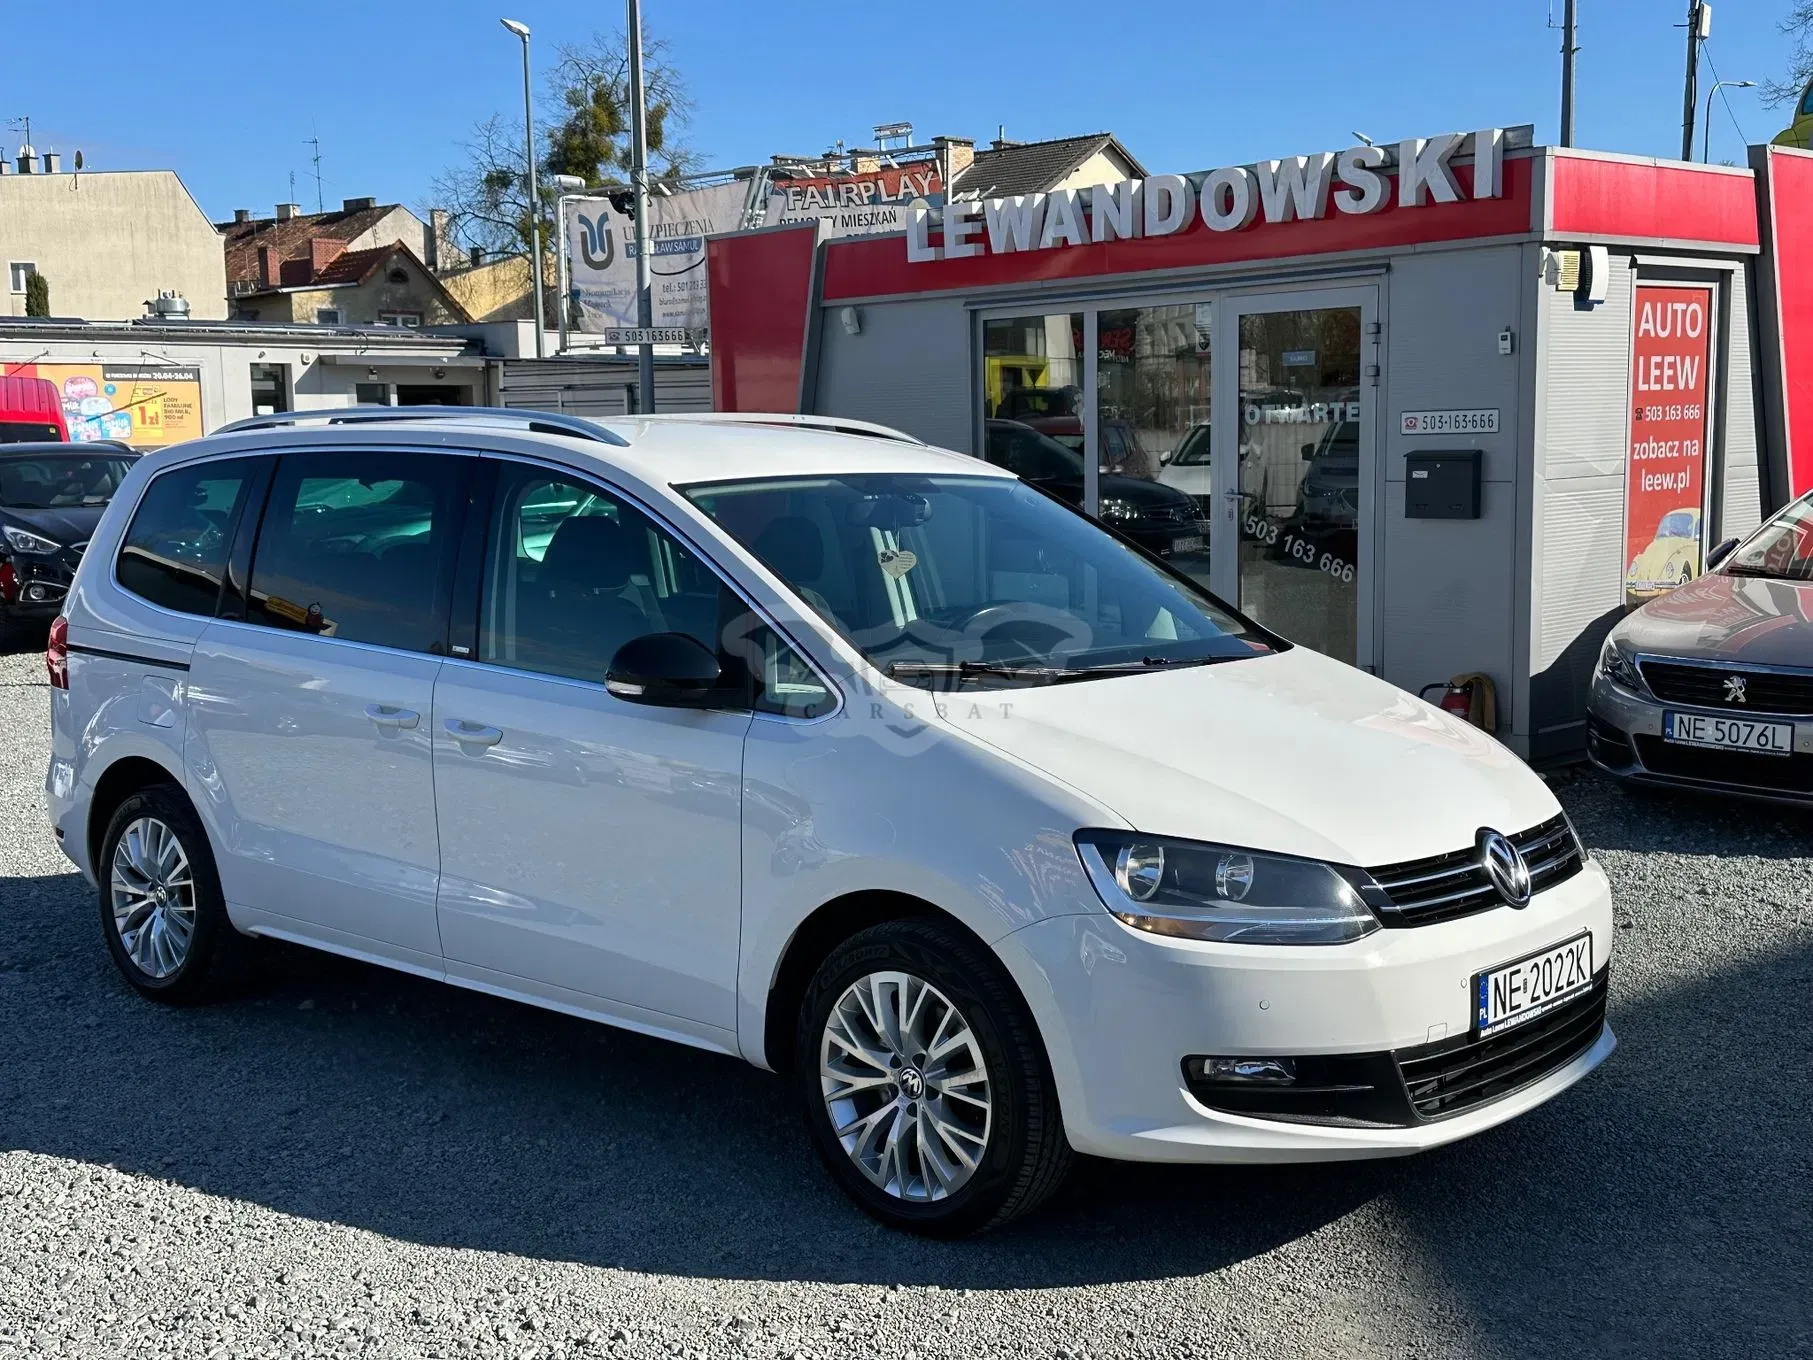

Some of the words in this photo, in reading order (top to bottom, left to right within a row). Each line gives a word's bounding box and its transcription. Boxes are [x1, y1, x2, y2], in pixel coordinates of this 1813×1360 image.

[785, 170, 934, 211] FAIRPLAY
[906, 127, 1504, 263] LEWANDOWSKI
[623, 218, 715, 241] UZPIECZENIA
[841, 206, 898, 228] MIESZKAŃ
[1638, 302, 1703, 338] AUTO
[1638, 355, 1699, 391] LEEW
[1245, 402, 1360, 425] OTWARTE
[1645, 405, 1662, 421] 503
[1664, 404, 1682, 421] 163
[1683, 403, 1700, 420] 666
[1633, 438, 1680, 460] zobacz
[1683, 439, 1699, 457] na
[1641, 465, 1690, 493] leew.pl
[1245, 515, 1277, 545] 503
[1284, 534, 1316, 563] 163
[1319, 552, 1354, 583] 666
[1679, 716, 1706, 740] NE
[1714, 720, 1784, 750] 5076L
[1493, 968, 1522, 1019] NE
[1530, 941, 1587, 1004] 2022K
[1479, 1008, 1487, 1020] PL
